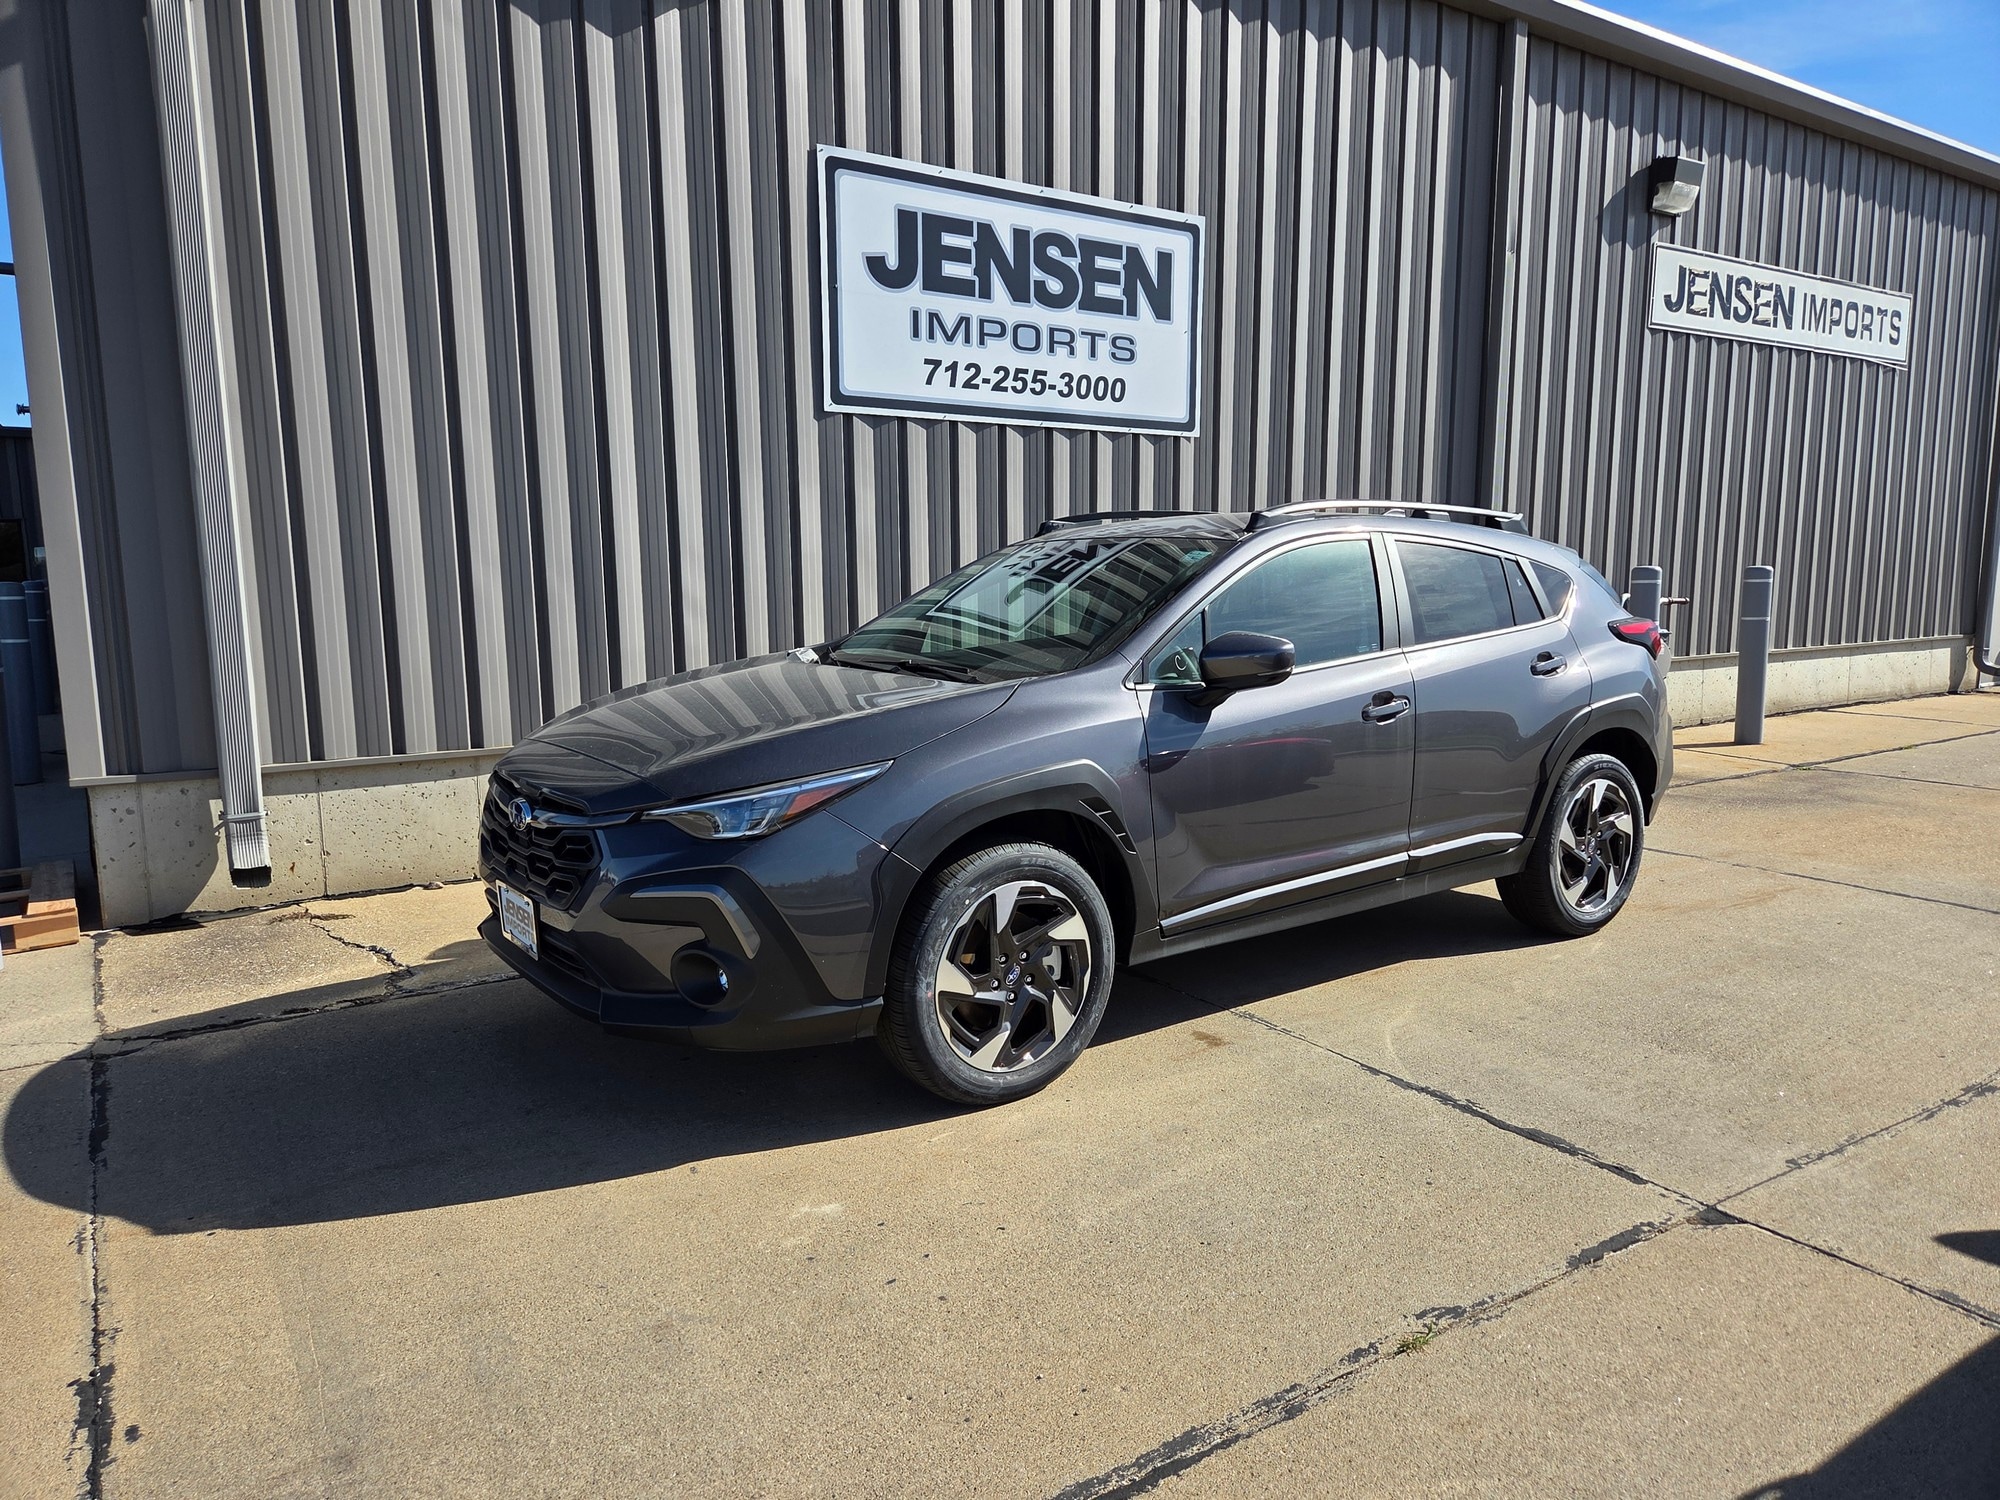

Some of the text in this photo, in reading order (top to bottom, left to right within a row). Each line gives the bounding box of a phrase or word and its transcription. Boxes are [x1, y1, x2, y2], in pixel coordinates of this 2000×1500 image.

[863, 205, 1174, 323] JENSEN
[910, 308, 1138, 364] IMPORTS
[1663, 264, 1902, 346] JENSEN IMPORTS
[922, 358, 1127, 403] 712-255-3000
